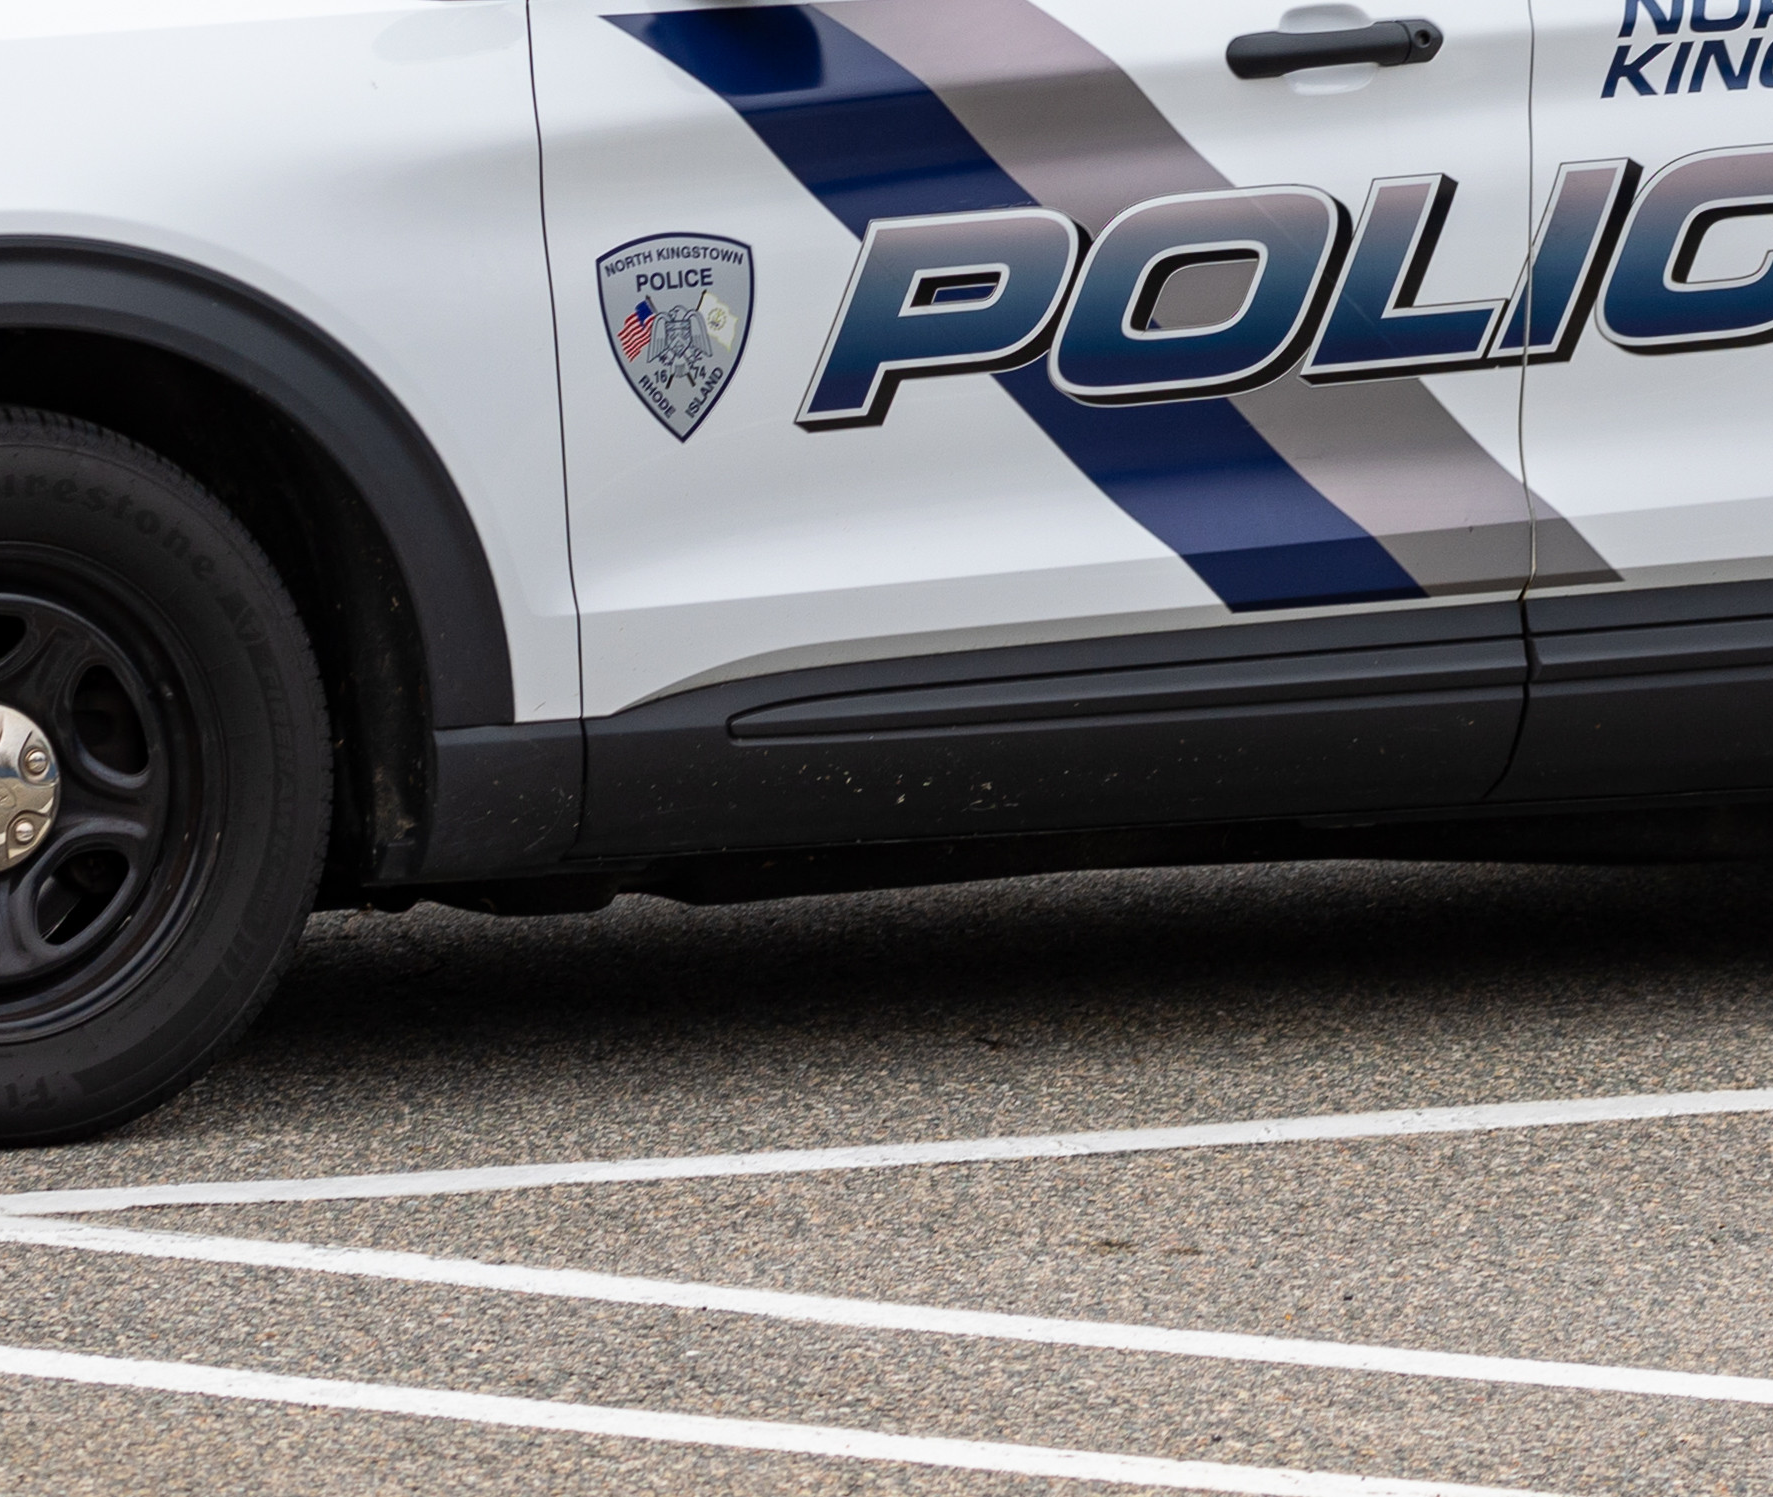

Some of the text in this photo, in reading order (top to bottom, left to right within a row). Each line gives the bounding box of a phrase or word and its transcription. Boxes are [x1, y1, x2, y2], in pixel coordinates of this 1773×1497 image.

[604, 245, 744, 277] NORTH KINGSTOWN
[635, 267, 714, 292] POLICE
[654, 366, 707, 383] 16 74
[638, 375, 676, 419] RHODE
[684, 366, 724, 418] ISLAND
